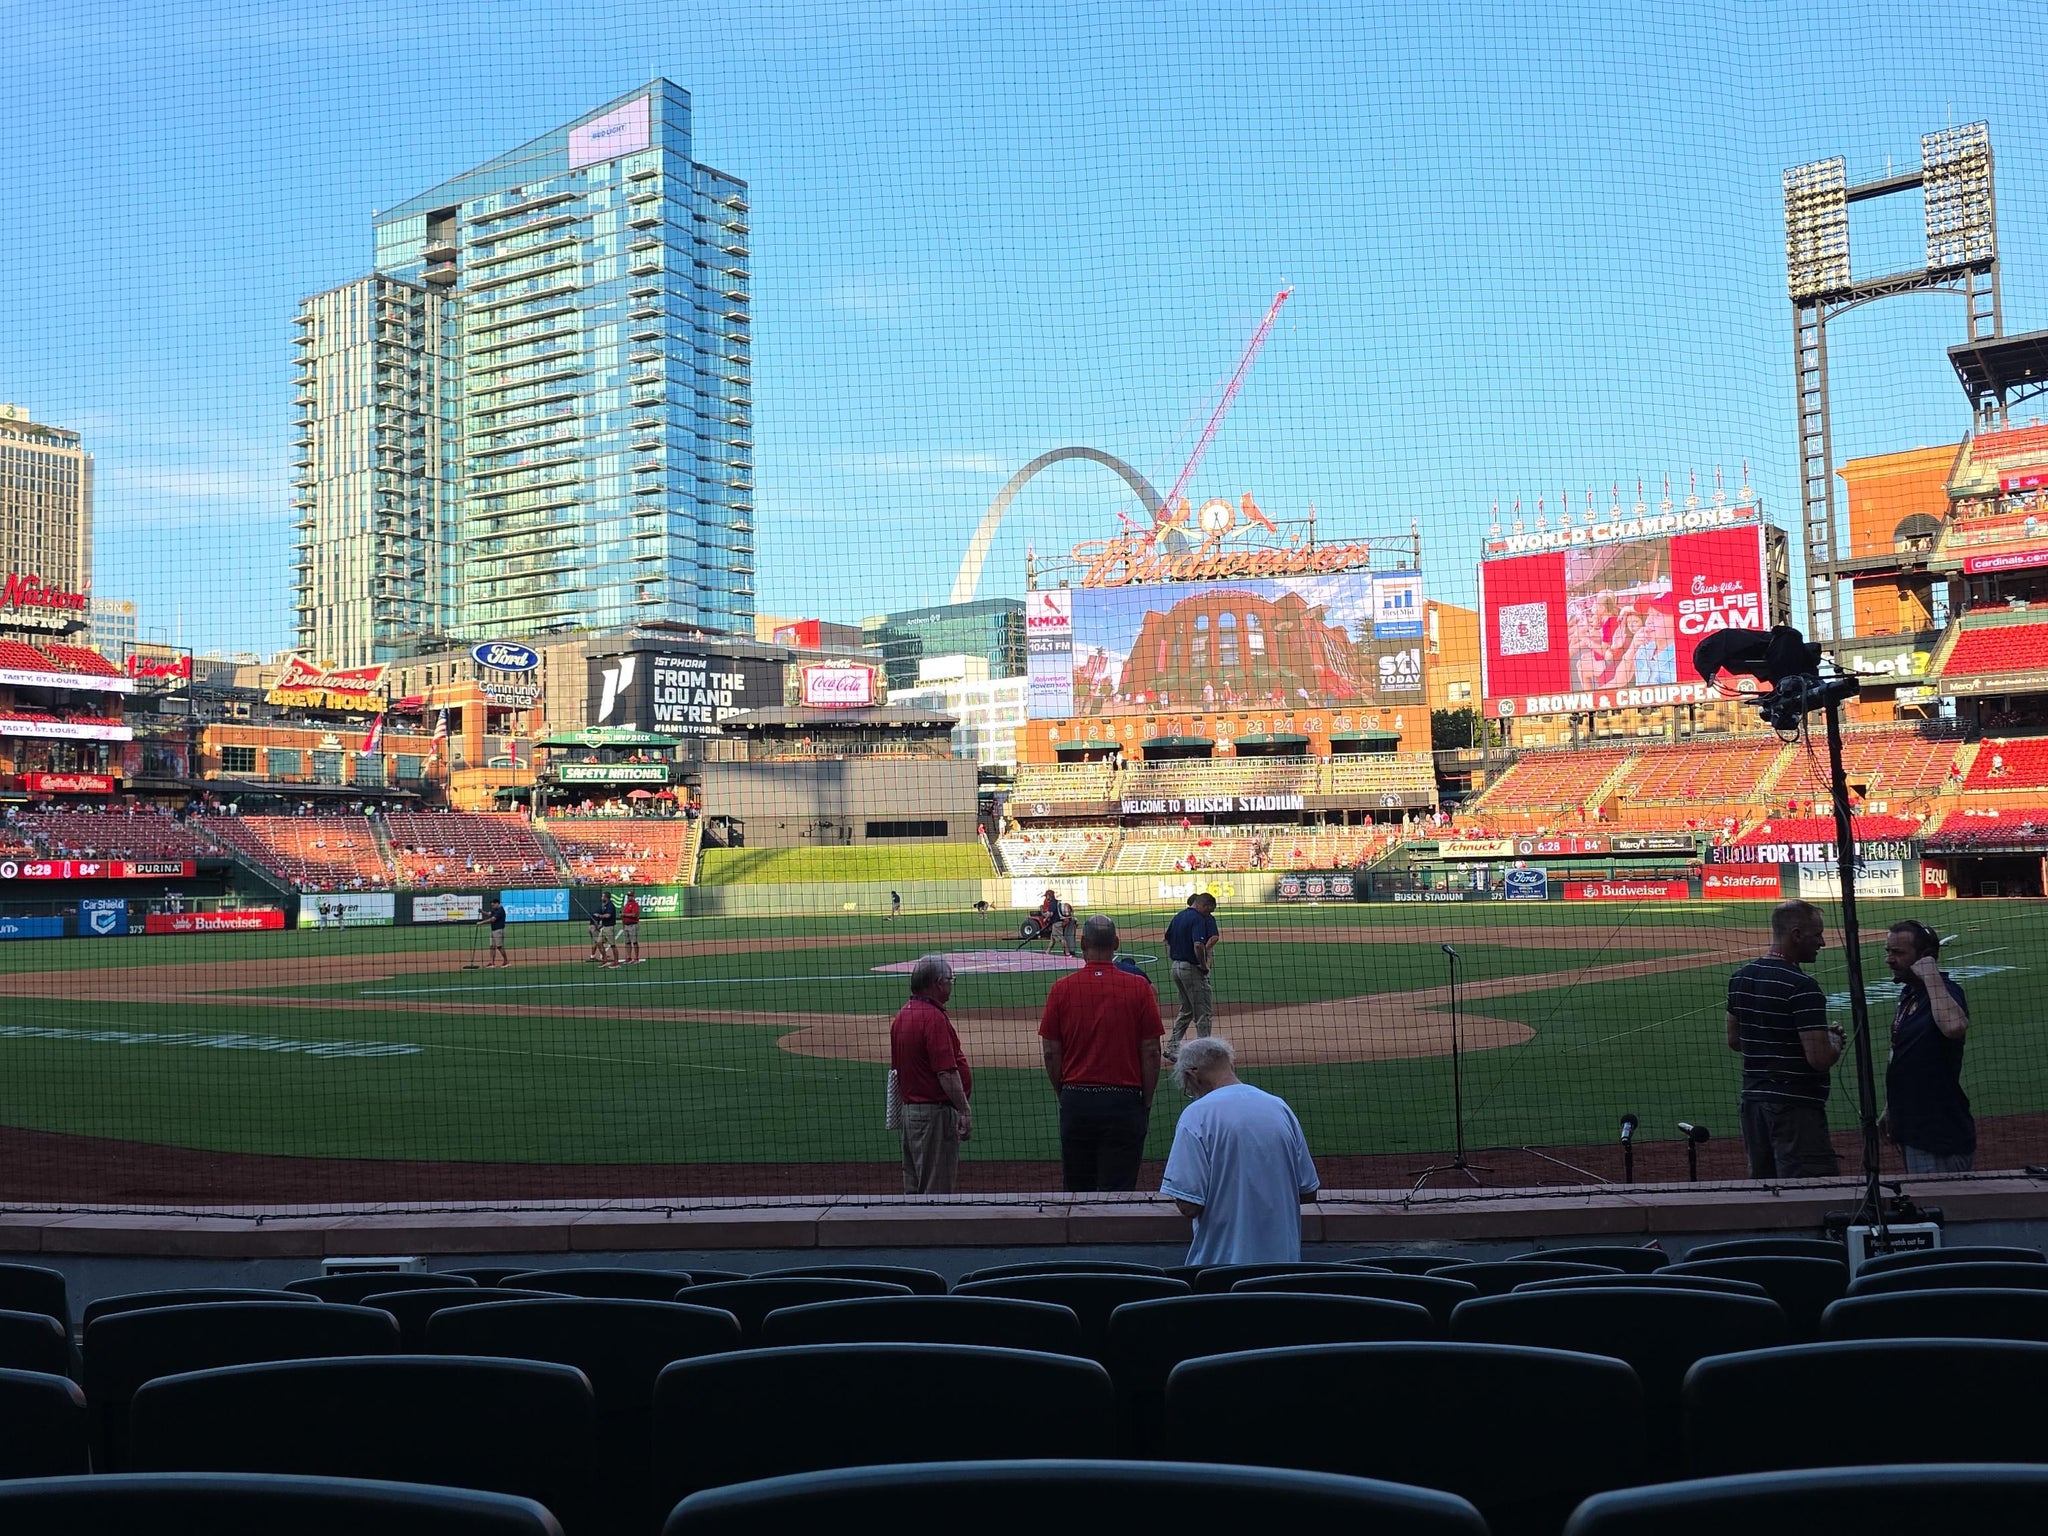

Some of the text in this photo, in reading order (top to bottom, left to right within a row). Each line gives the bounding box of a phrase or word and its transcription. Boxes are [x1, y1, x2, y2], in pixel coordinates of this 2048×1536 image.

[1506, 508, 1735, 552] WORLD CHAMPIONS
[1072, 536, 1370, 588] Budweiser
[1975, 553, 2048, 568] cardinals.com
[0, 573, 84, 611] Nation
[1678, 592, 1758, 614] SELFIE
[0, 614, 68, 629] ROOFTOP
[907, 617, 929, 626] Anthem
[1028, 616, 1070, 627] KMOX
[1679, 607, 1759, 634] CAM
[1030, 642, 1070, 651] 104.1 FM
[487, 645, 529, 666] Ford
[1379, 649, 1420, 675] stl
[1853, 651, 1931, 677] bet3
[278, 665, 382, 690] Budweiser
[654, 669, 745, 690] FROM THE
[1380, 674, 1420, 684] TODAY
[479, 681, 540, 698] Community
[1950, 683, 1975, 691] Mercy
[269, 689, 388, 712] BREW HOUSE
[654, 687, 732, 707] LOU AND
[1527, 682, 1721, 713] BROWN & CROUPPEN
[654, 704, 712, 722] WE'RE
[1089, 726, 1098, 740] 2
[1124, 724, 1134, 740] 9
[1144, 723, 1158, 739] 10
[1167, 722, 1182, 738] 14
[1191, 721, 1206, 737] 17
[1216, 722, 1234, 736] 20
[1247, 720, 1265, 734] 23
[1274, 718, 1293, 733] 24
[1303, 718, 1322, 733] 42
[1333, 716, 1352, 731] 45
[1360, 715, 1379, 730] 85
[566, 768, 662, 778] SAFETY NATIONAL
[1121, 795, 1303, 814] WELCOME TO BUSCH STADIUM
[1445, 842, 1506, 851] Schnucks
[1538, 842, 1560, 851] 6:28
[1620, 841, 1640, 849] Mercy
[1758, 844, 1790, 862] FOR
[1792, 843, 1825, 862] THE
[24, 864, 51, 876] 6:28
[137, 864, 180, 873] PURINA
[1514, 872, 1537, 882] Ford
[1395, 893, 1463, 901] BUSCH STADIUM
[1602, 885, 1667, 896] Budweiser
[83, 900, 124, 910] CarShield
[130, 925, 144, 934] 375'
[195, 917, 262, 930] Budweiser
[1917, 1237, 1926, 1245] for
